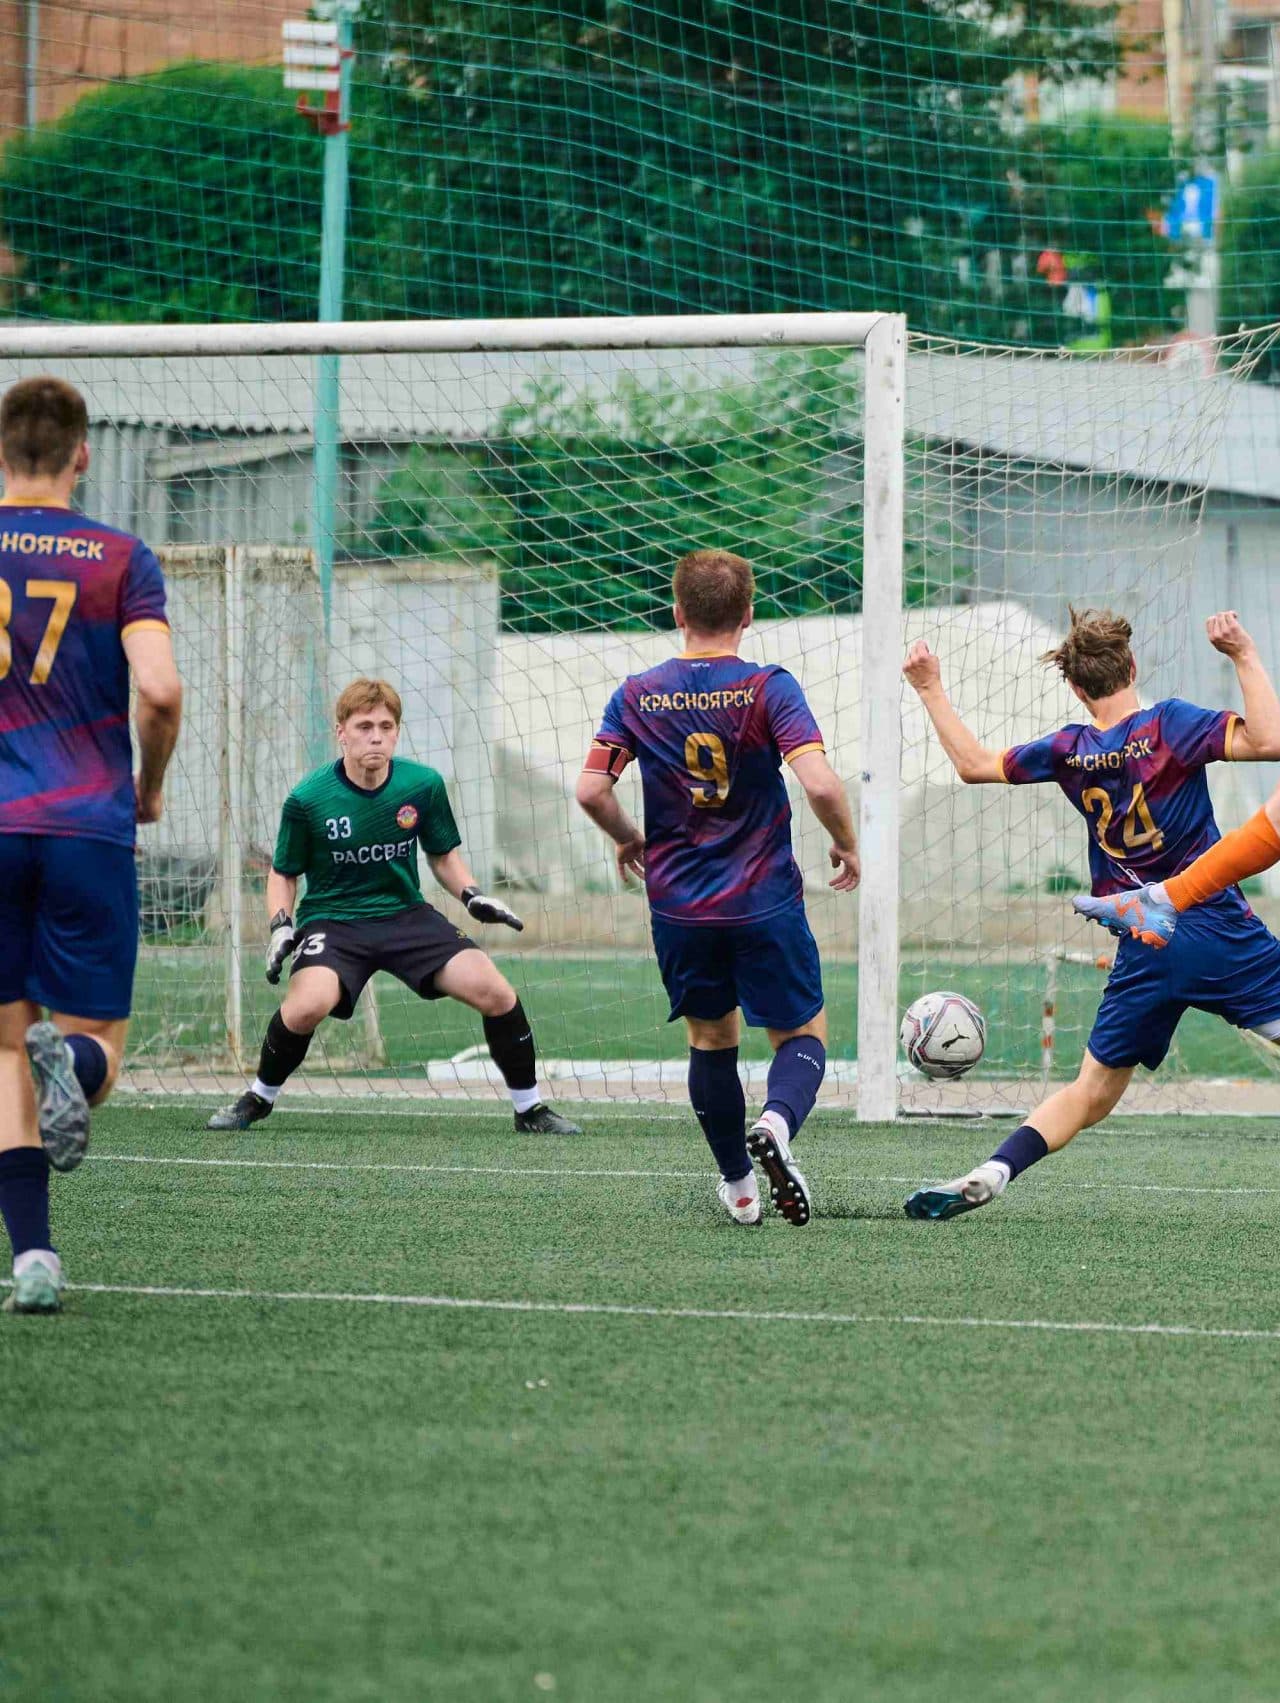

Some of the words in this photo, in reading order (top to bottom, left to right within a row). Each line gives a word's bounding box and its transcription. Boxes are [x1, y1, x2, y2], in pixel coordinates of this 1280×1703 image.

[0, 531, 104, 560] НОЯРСК
[0, 577, 77, 684] 7
[639, 687, 755, 712] КРАСНОЯРСК
[684, 732, 730, 808] 9
[325, 816, 352, 840] 33
[1081, 782, 1165, 858] 24
